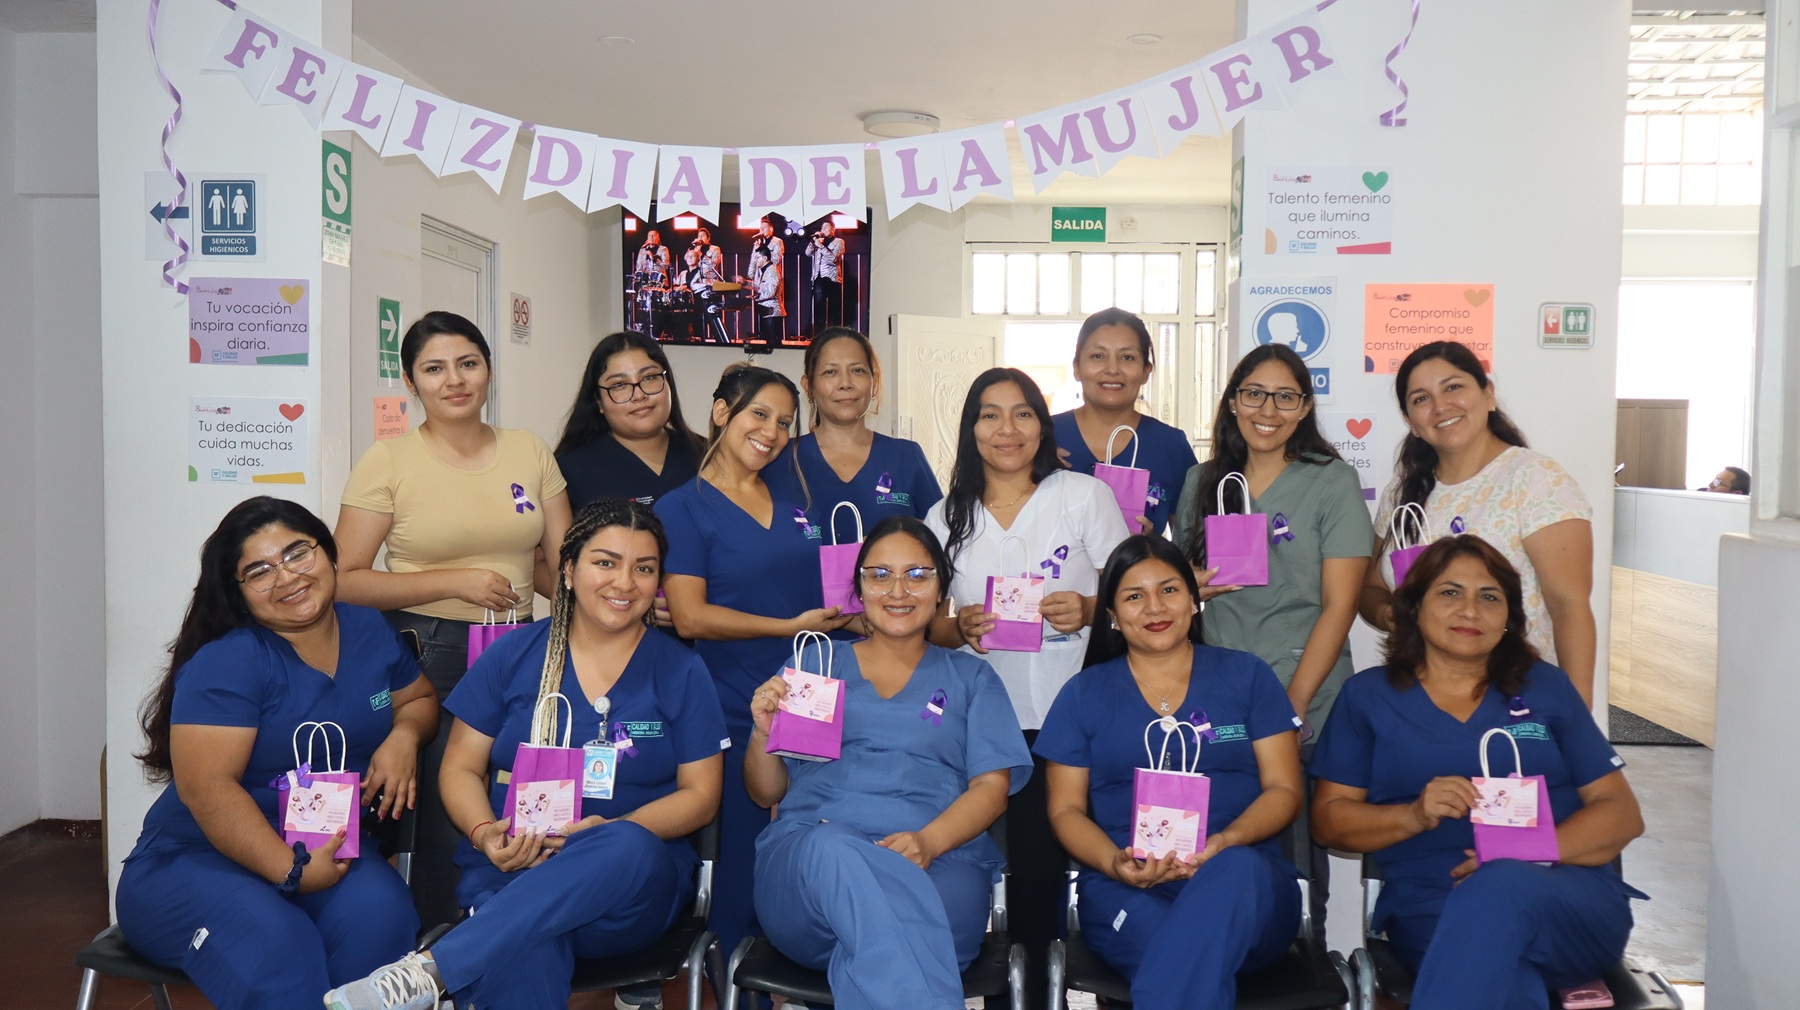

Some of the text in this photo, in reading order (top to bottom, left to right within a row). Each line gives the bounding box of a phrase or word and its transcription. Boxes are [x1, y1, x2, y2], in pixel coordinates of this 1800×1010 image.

[224, 19, 1333, 207] FELIZ DIA DE LA MUJER
[325, 151, 348, 215] S
[1268, 191, 1392, 204] Talento femenino
[1288, 209, 1370, 224] que ilumina
[1053, 219, 1104, 230] SALIDA
[1296, 227, 1360, 240] caminos.
[211, 237, 246, 245] SERVICIOS
[1249, 286, 1333, 295] AGRADECEMOS
[206, 301, 292, 315] Tu vocación
[1389, 307, 1471, 320] Compromiso
[190, 318, 308, 333] inspira confianza
[1385, 323, 1474, 337] femenino que
[226, 337, 270, 350] diaria.
[380, 359, 399, 371] SALIDA
[198, 420, 293, 434] Tu dedicación
[198, 437, 293, 451] cuida muchas
[226, 455, 264, 467] vidas.
